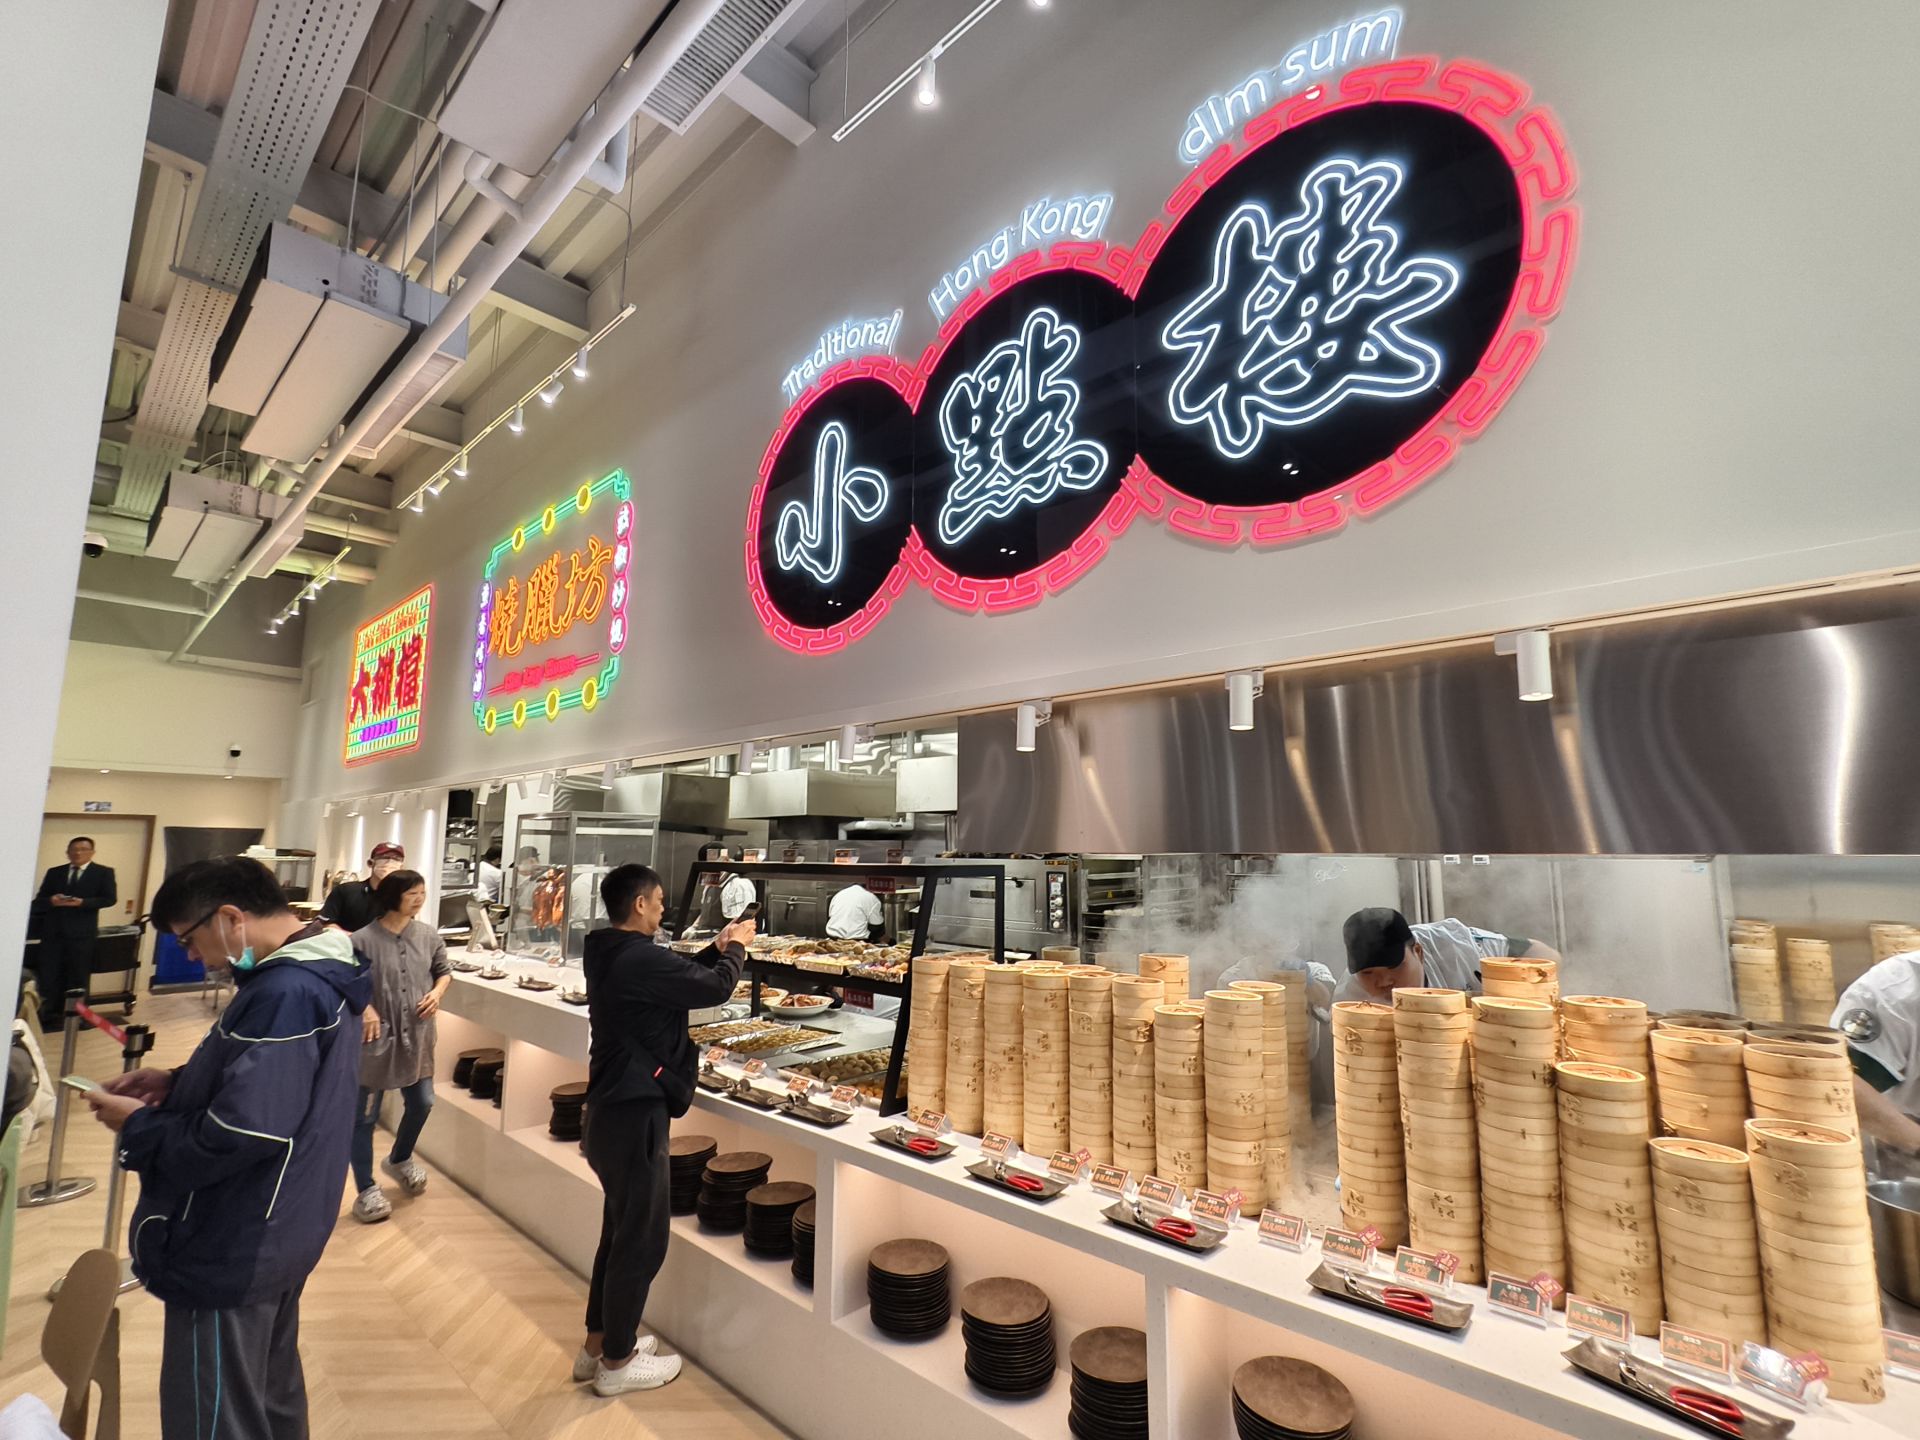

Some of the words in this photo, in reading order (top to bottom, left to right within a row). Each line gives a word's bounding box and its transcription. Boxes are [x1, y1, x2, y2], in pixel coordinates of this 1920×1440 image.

[782, 312, 899, 396] Traditional
[930, 230, 1010, 316] Hong
[1021, 197, 1107, 247] Kong
[1184, 77, 1267, 155] dim
[1282, 15, 1392, 85] sum
